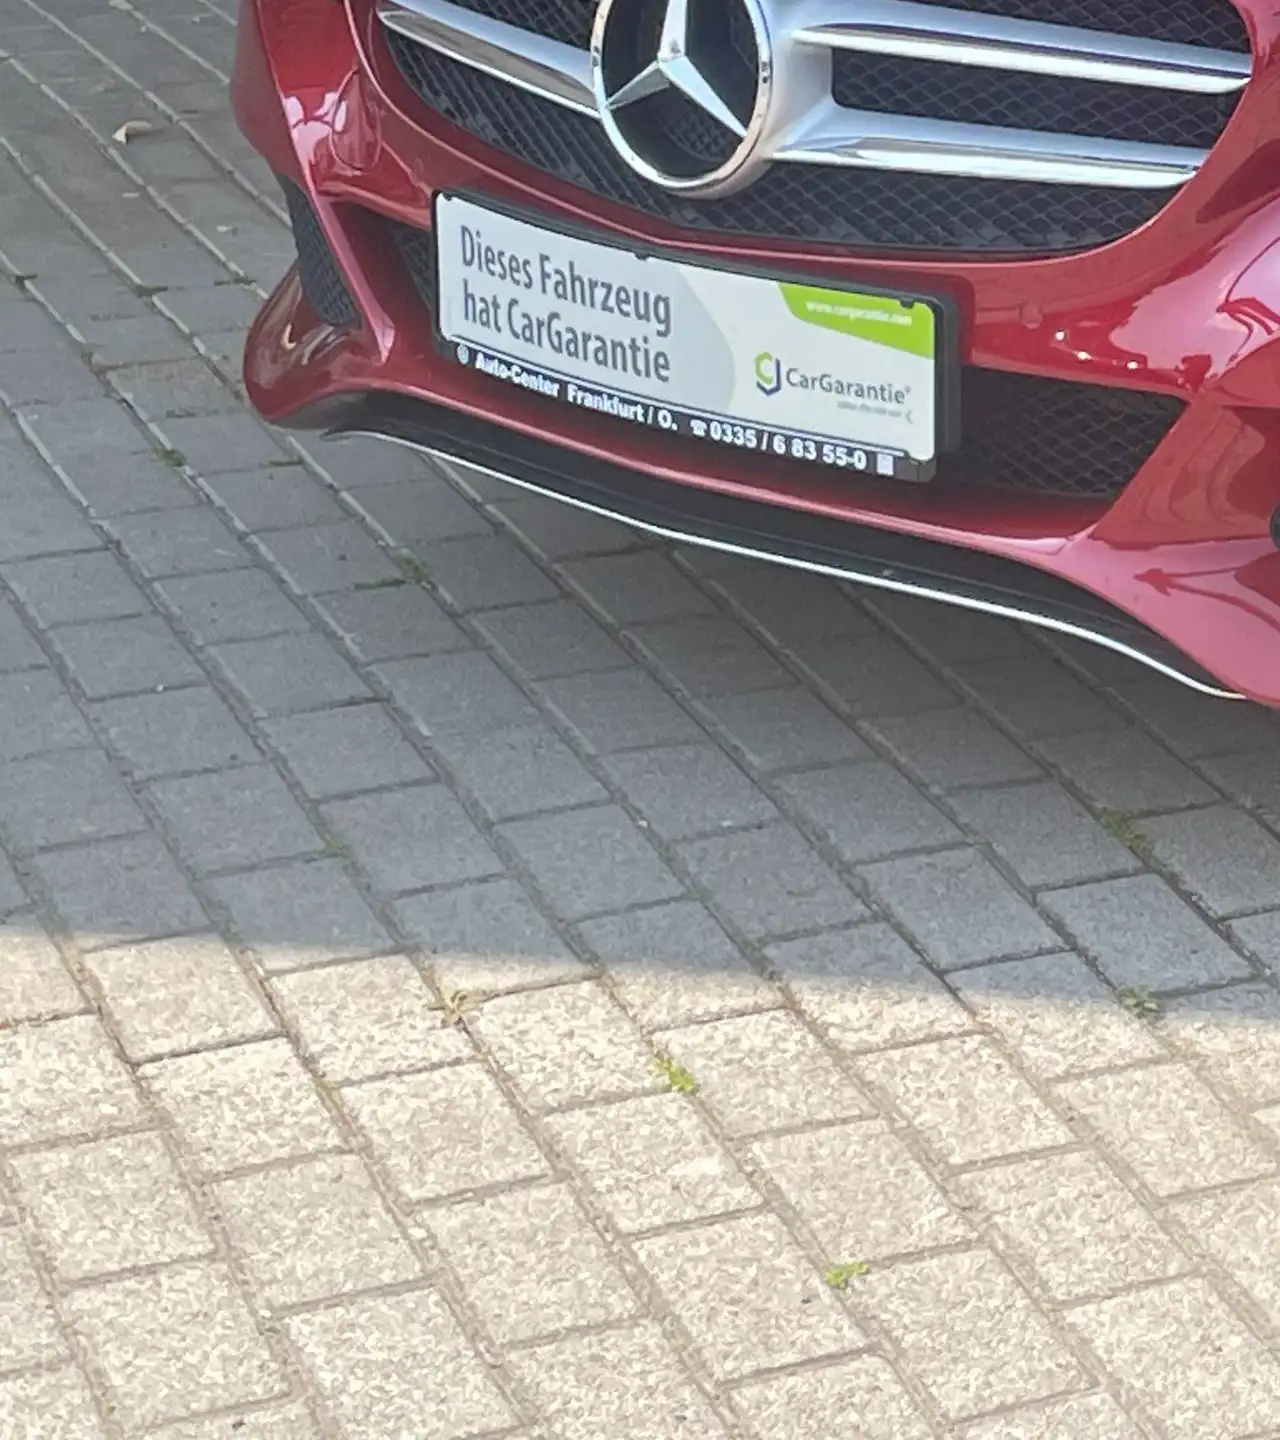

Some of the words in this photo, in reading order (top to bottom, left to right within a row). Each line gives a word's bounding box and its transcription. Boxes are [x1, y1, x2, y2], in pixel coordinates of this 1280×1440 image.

[460, 225, 533, 289] Dieses
[538, 251, 672, 338] Fahrzeug
[463, 278, 502, 334] hat
[507, 298, 671, 383] CarGarantie
[566, 383, 645, 423] Frankfurt
